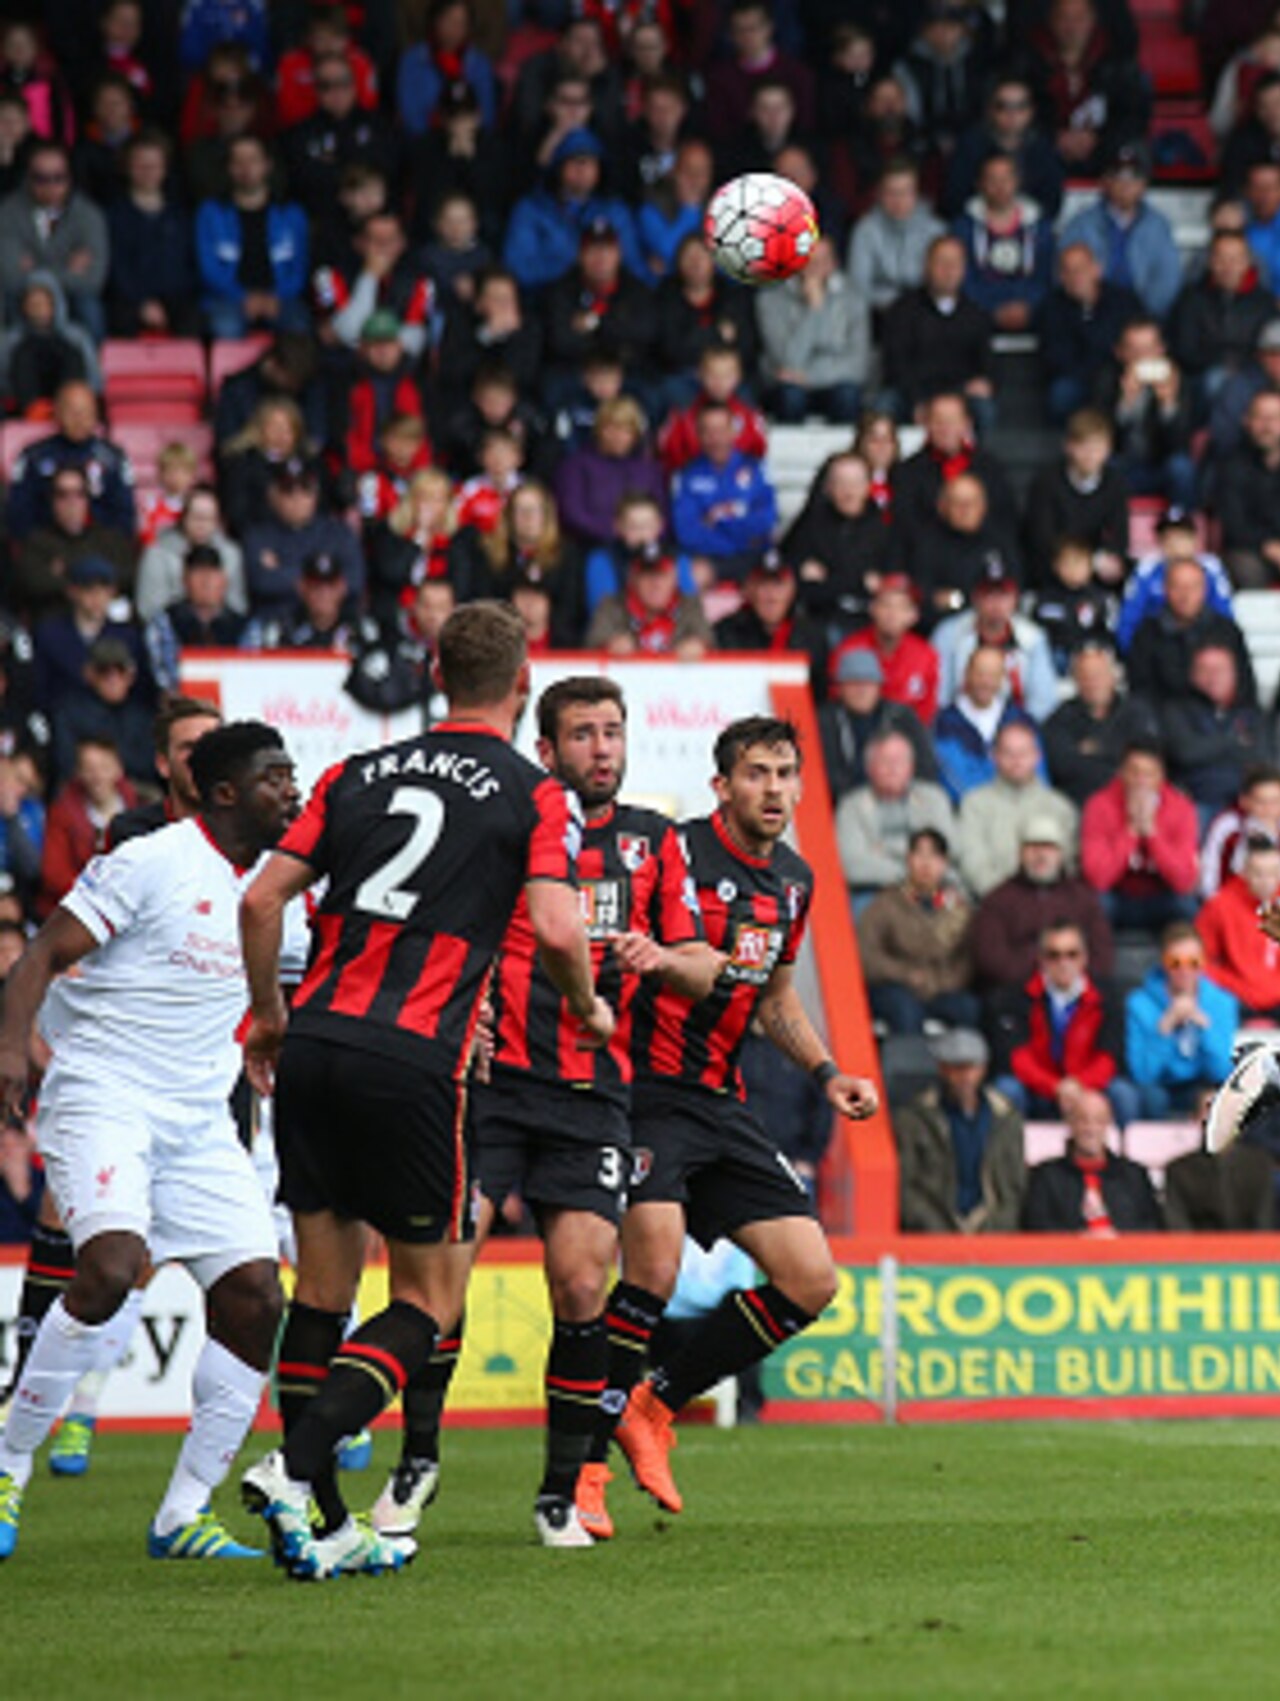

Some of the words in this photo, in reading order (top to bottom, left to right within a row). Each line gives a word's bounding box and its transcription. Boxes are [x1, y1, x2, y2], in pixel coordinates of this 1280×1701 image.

[361, 749, 500, 799] FRANCIS
[354, 785, 445, 920] 2
[598, 1147, 622, 1188] 3
[783, 1349, 1035, 1398] GARDEN
